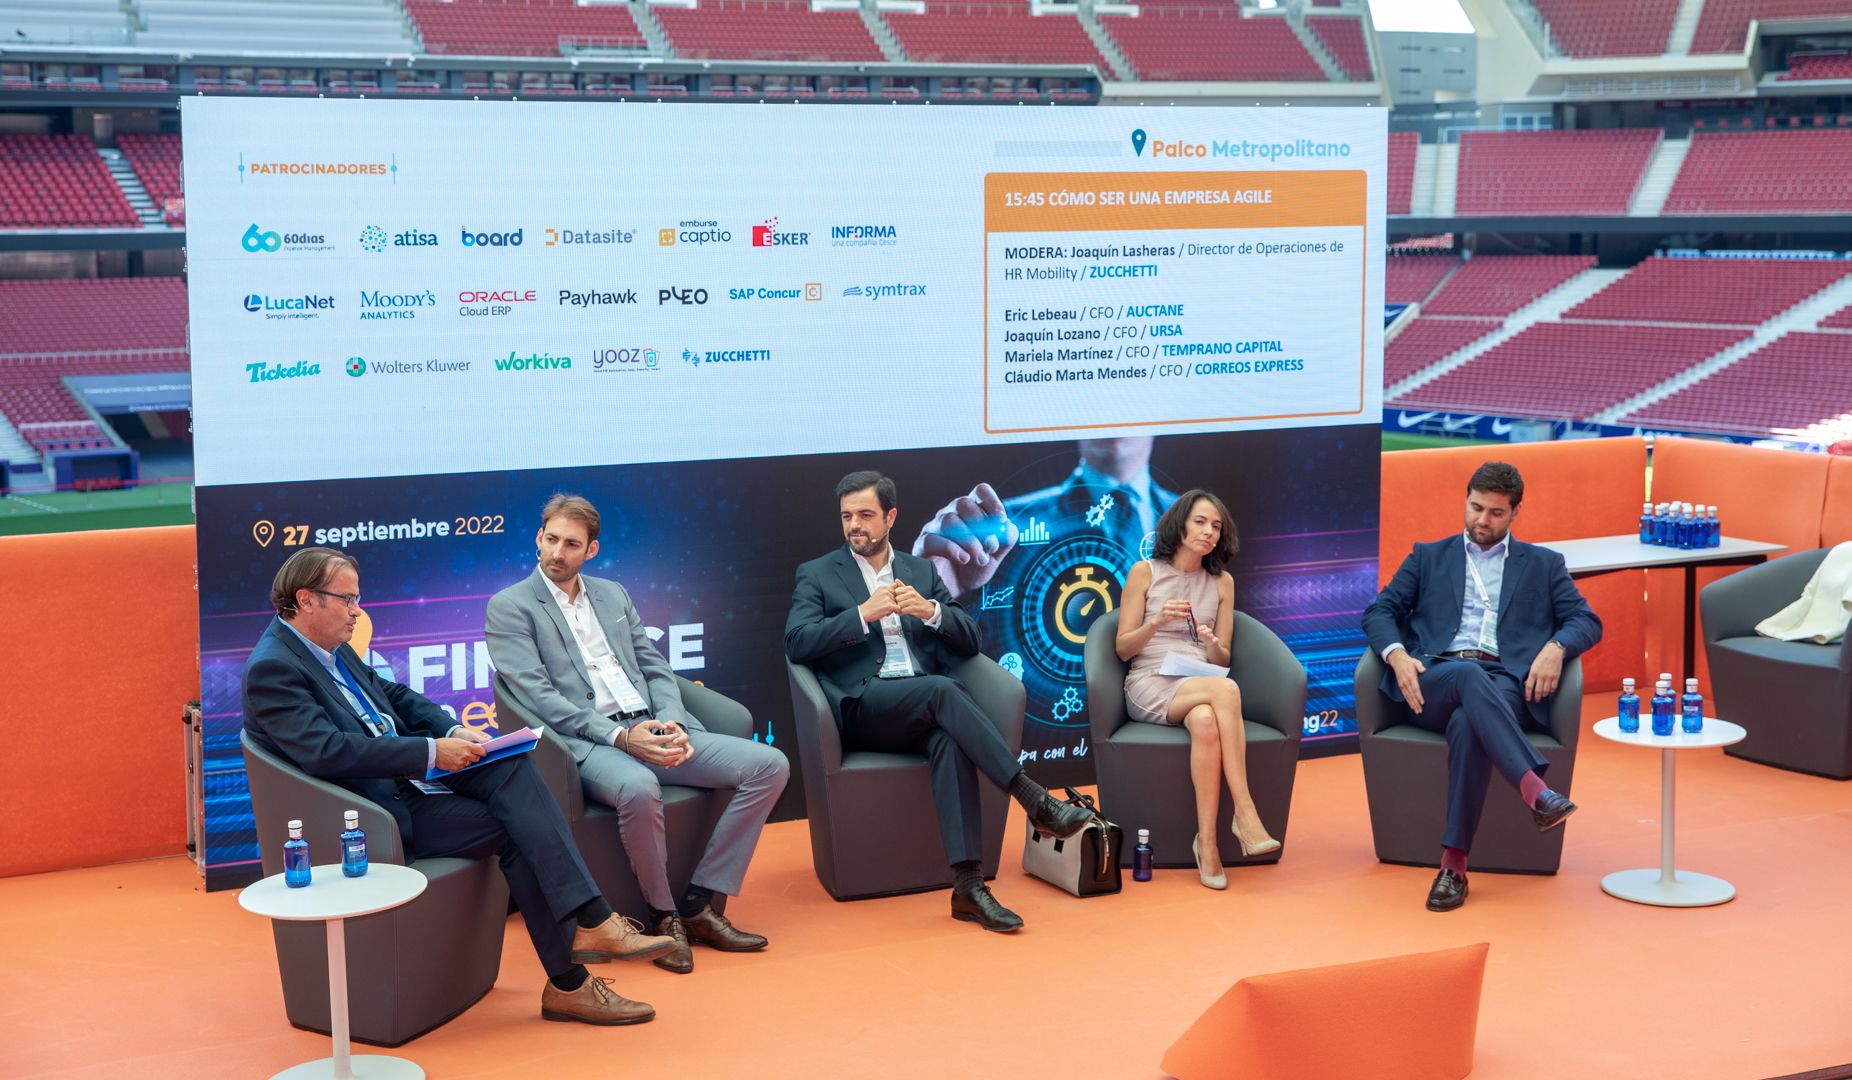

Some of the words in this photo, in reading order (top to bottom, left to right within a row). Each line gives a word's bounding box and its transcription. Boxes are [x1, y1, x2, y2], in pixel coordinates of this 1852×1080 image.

[1152, 140, 1207, 158] Palco
[1212, 140, 1350, 162] Metropolitano
[251, 164, 386, 174] PATROCINADORES
[1005, 192, 1044, 206] 15:45
[1049, 189, 1095, 206] CÓMO
[1100, 191, 1124, 204] SER
[1129, 191, 1160, 204] UNA
[1165, 191, 1230, 204] EMPRESA
[1234, 190, 1272, 203] AGILE
[394, 229, 438, 247] atisa
[462, 226, 522, 247] board
[680, 229, 731, 245] captio
[832, 225, 896, 239] INFORMA
[1005, 246, 1068, 260] MODERA:
[1070, 246, 1119, 260] Joaquín
[1123, 244, 1175, 257] Lasheras
[1179, 243, 1184, 257] /
[1188, 243, 1235, 256] Director
[1239, 243, 1252, 254] de
[1256, 242, 1327, 256] Operaciones
[1330, 241, 1343, 252] de
[1005, 268, 1022, 280] HR
[1027, 266, 1077, 282] Mobility
[1081, 266, 1086, 280] /
[1089, 265, 1157, 278] ZUCCHETTI
[459, 290, 536, 303] ORACLE
[560, 289, 637, 308] Payhawk
[730, 289, 755, 300] SAP
[758, 287, 800, 299] Concur
[865, 283, 926, 300] symtrax
[265, 295, 335, 310] LucaNet
[360, 310, 414, 320] ANALYTICS
[459, 307, 488, 317] Cloud
[491, 306, 511, 315] ERP
[1005, 308, 1028, 321] Eric
[1032, 308, 1077, 320] Lebeau
[1080, 306, 1086, 321] /
[1089, 306, 1114, 319] CFO
[1117, 306, 1123, 320] /
[1126, 304, 1184, 318] AUCTANE
[1005, 328, 1053, 344] Joaquín
[1058, 328, 1100, 341] Lozano
[1104, 326, 1110, 341] /
[1113, 326, 1137, 338] CFO
[1141, 325, 1146, 340] /
[1150, 325, 1182, 337] URSA
[705, 350, 770, 362] ZUCCHETTI
[1005, 349, 1054, 363] Mariela
[1058, 347, 1113, 361] Martínez
[1116, 346, 1122, 361] /
[1126, 346, 1150, 358] CFO
[1153, 345, 1159, 359] /
[1162, 343, 1232, 357] TEMPRANO
[1236, 341, 1283, 354] CAPITAL
[246, 361, 321, 382] Tickelia
[372, 362, 422, 374] Wolters
[427, 360, 471, 372] Kluwer
[1005, 369, 1052, 383] Cláudio
[1056, 369, 1094, 381] Marta
[1098, 366, 1146, 380] Mendes
[1150, 365, 1156, 380] /
[1159, 365, 1183, 377] CFO
[1186, 364, 1192, 378] /
[1195, 361, 1251, 375] CORREOS
[1254, 359, 1303, 373] EXPRESS
[283, 526, 309, 546] 27
[315, 518, 449, 547] septiembre
[455, 516, 504, 535] 2022
[1043, 746, 1066, 759] con
[1072, 737, 1088, 757] el
